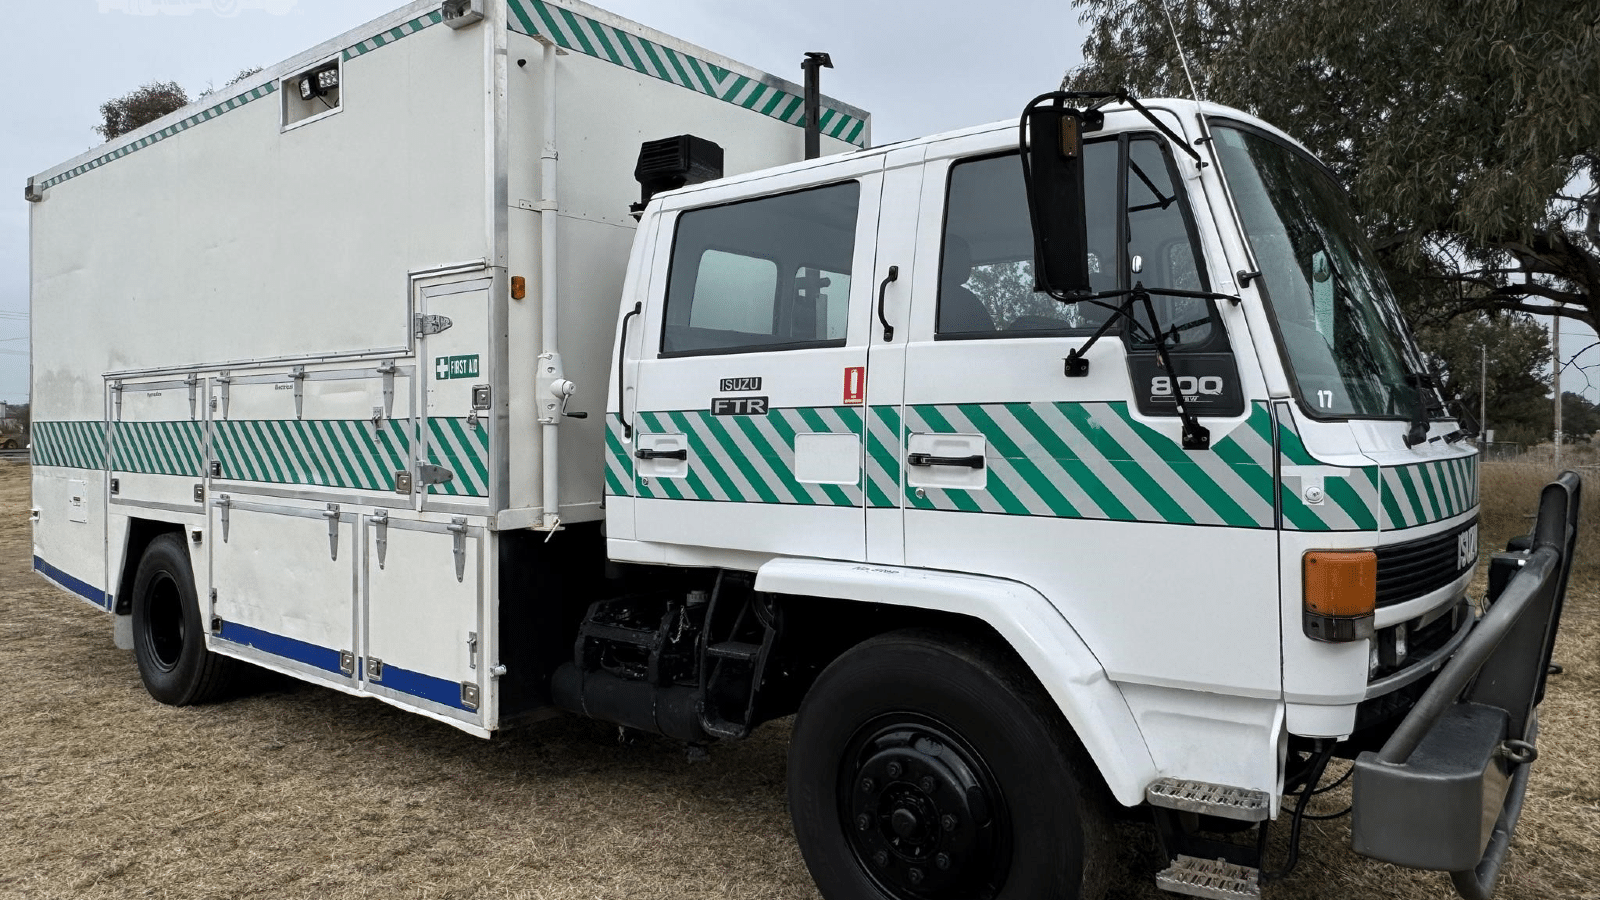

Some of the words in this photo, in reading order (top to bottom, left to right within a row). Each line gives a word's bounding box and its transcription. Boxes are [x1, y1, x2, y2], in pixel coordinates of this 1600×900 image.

[450, 359, 467, 375] FIRST
[468, 358, 478, 374] AID
[721, 377, 759, 391] ISUZU
[714, 399, 766, 414] FTR
[1317, 389, 1333, 409] 17
